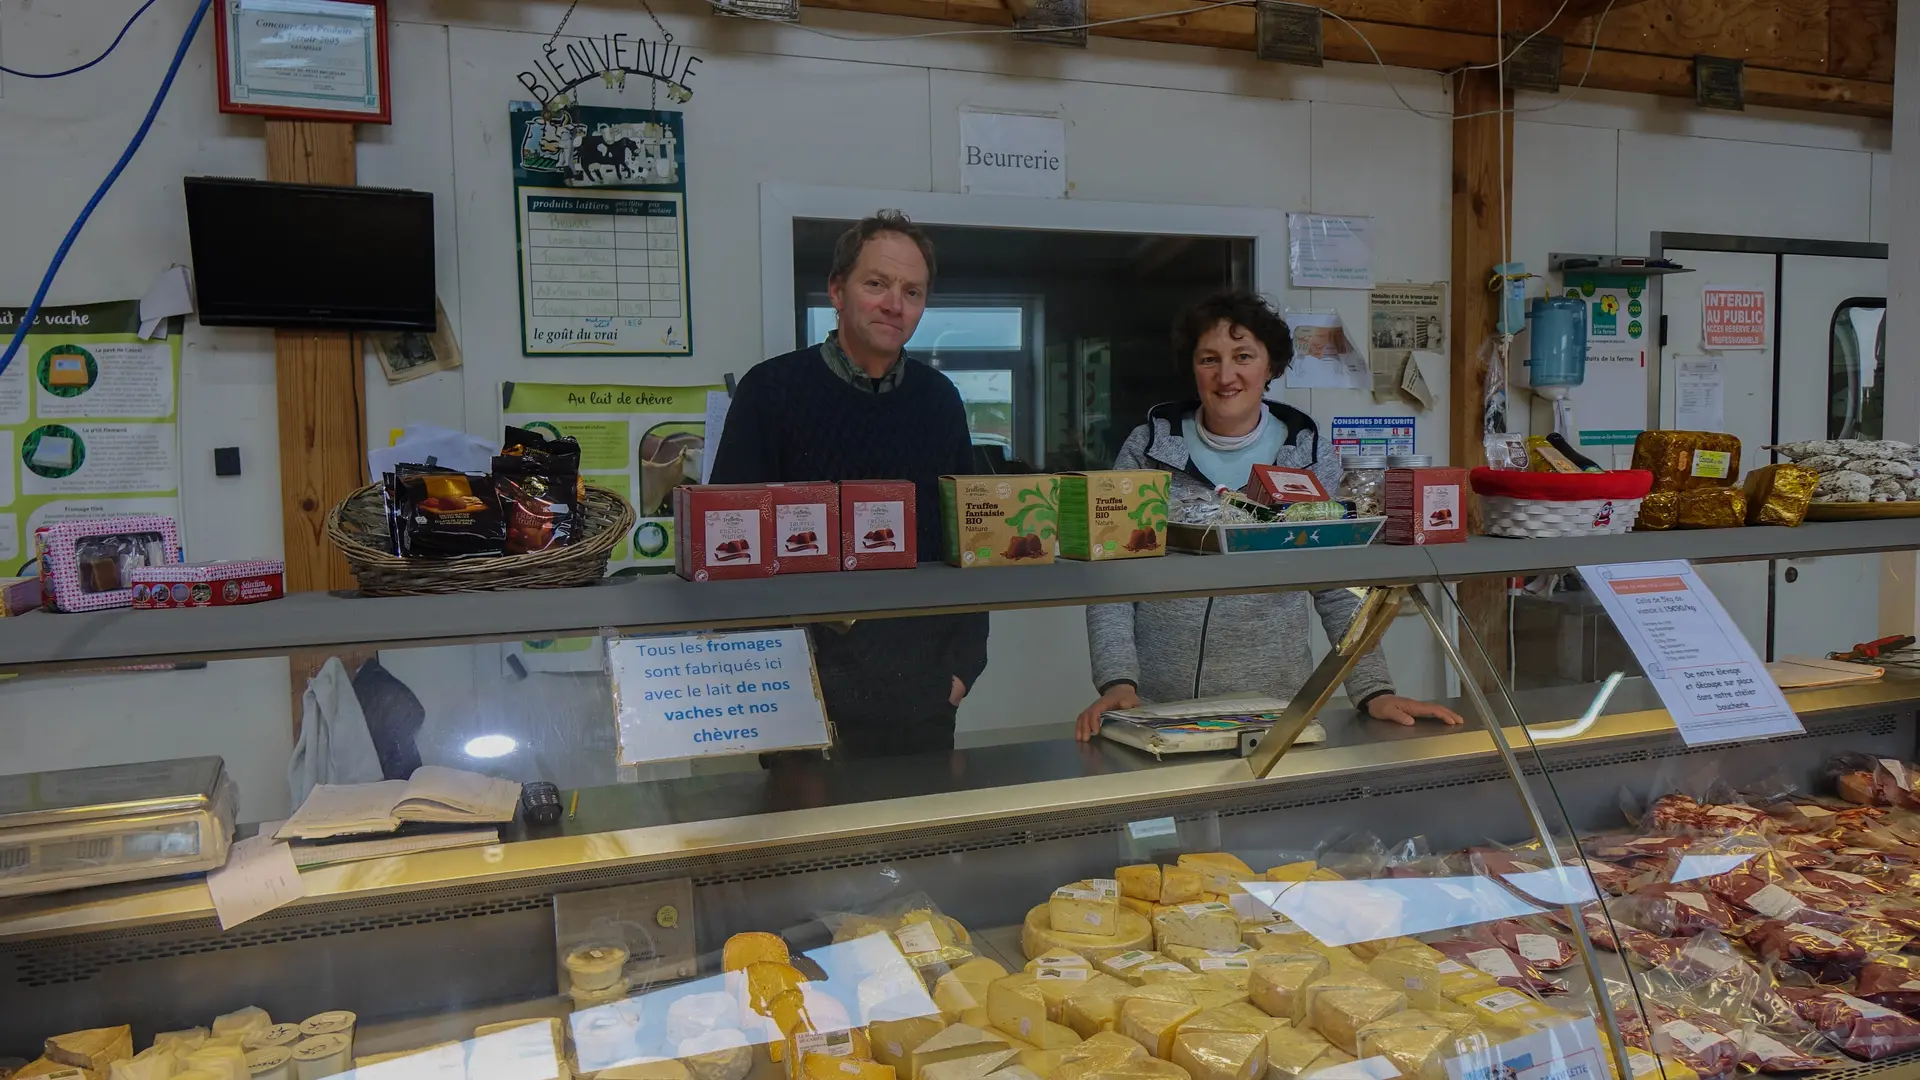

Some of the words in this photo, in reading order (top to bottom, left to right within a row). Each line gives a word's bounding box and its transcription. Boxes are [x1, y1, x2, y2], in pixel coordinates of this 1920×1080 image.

[516, 33, 703, 105] BIENVENUE
[966, 145, 1060, 171] Beurrerie
[532, 201, 574, 212] produits
[576, 202, 610, 211] laitiers
[1706, 293, 1763, 308] INTERDIT
[45, 310, 91, 326] vache
[1707, 310, 1720, 323] AU
[1724, 310, 1763, 324] PUBLIC
[534, 328, 544, 340] le
[547, 328, 574, 343] goût
[577, 328, 591, 340] du
[594, 329, 618, 340] vrai
[1725, 325, 1750, 333] RESERVE
[1617, 355, 1634, 363] ferme
[568, 392, 586, 406] Au
[590, 391, 613, 405] lait
[617, 392, 632, 405] de
[636, 391, 674, 407] chèvre
[965, 502, 999, 510] Truffes
[1095, 497, 1123, 505] Truffes
[965, 510, 1005, 518] fantaisie
[1095, 504, 1128, 512] fantaisie
[965, 517, 983, 525] BIO
[1095, 519, 1114, 527] Nature
[636, 643, 676, 657] Tous
[680, 641, 703, 654] les
[706, 638, 783, 656] fromages
[644, 665, 680, 679] sont
[685, 658, 761, 676] fabriqués
[765, 658, 782, 669] ici
[1684, 670, 1695, 679] De
[1696, 670, 1715, 678] notre
[1716, 667, 1742, 678] élevage
[1695, 680, 1723, 690] découpe
[1724, 680, 1736, 688] sur
[1738, 677, 1755, 688] place
[644, 687, 683, 701] avec
[687, 684, 702, 697] le
[706, 683, 732, 696] lait
[736, 680, 758, 694] de
[762, 680, 791, 692] nos
[1696, 692, 1713, 701] dans
[1714, 691, 1733, 700] notre
[1734, 688, 1757, 698] atelier
[664, 706, 723, 722] vaches
[727, 703, 745, 716] et
[749, 701, 779, 714] nos
[1716, 701, 1751, 712] boucherie
[693, 726, 760, 744] chèvres
